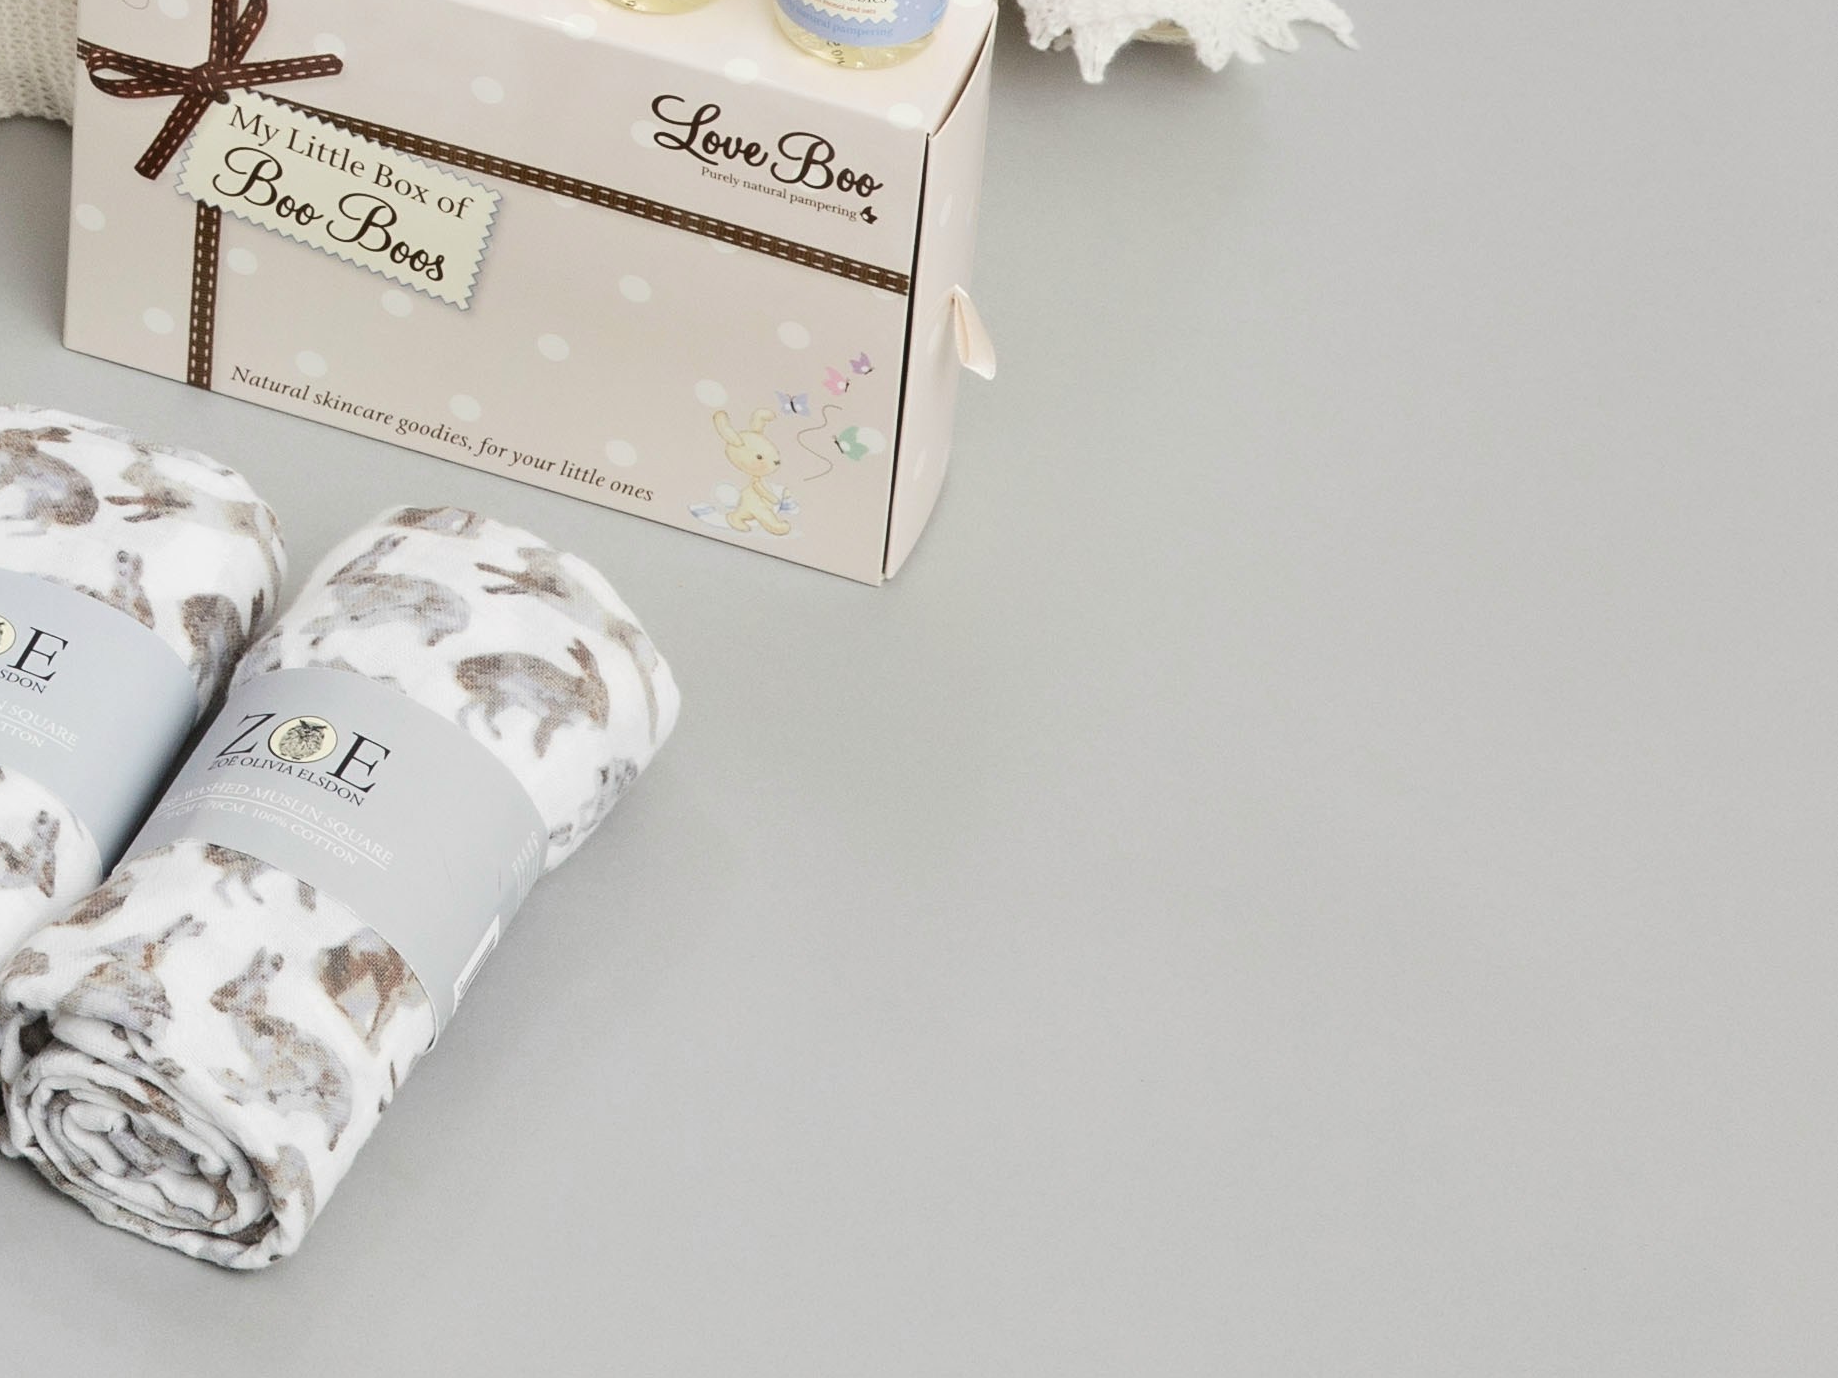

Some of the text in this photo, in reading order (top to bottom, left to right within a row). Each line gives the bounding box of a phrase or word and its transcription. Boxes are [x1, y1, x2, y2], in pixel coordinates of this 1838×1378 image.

[229, 105, 474, 221] My Little Box of
[651, 94, 883, 198] Love Boo
[213, 146, 445, 281] Boo Boos
[701, 166, 857, 221] Purely natural pampering
[230, 365, 654, 502] Natural skincare goodies, for your little ones
[9, 702, 80, 747] SQUARE
[240, 758, 292, 775] OLIVIA
[297, 768, 365, 807] ELSDON
[252, 786, 324, 822] MUSLIN
[324, 815, 394, 865] SQUARE
[291, 822, 358, 865] COTTON
